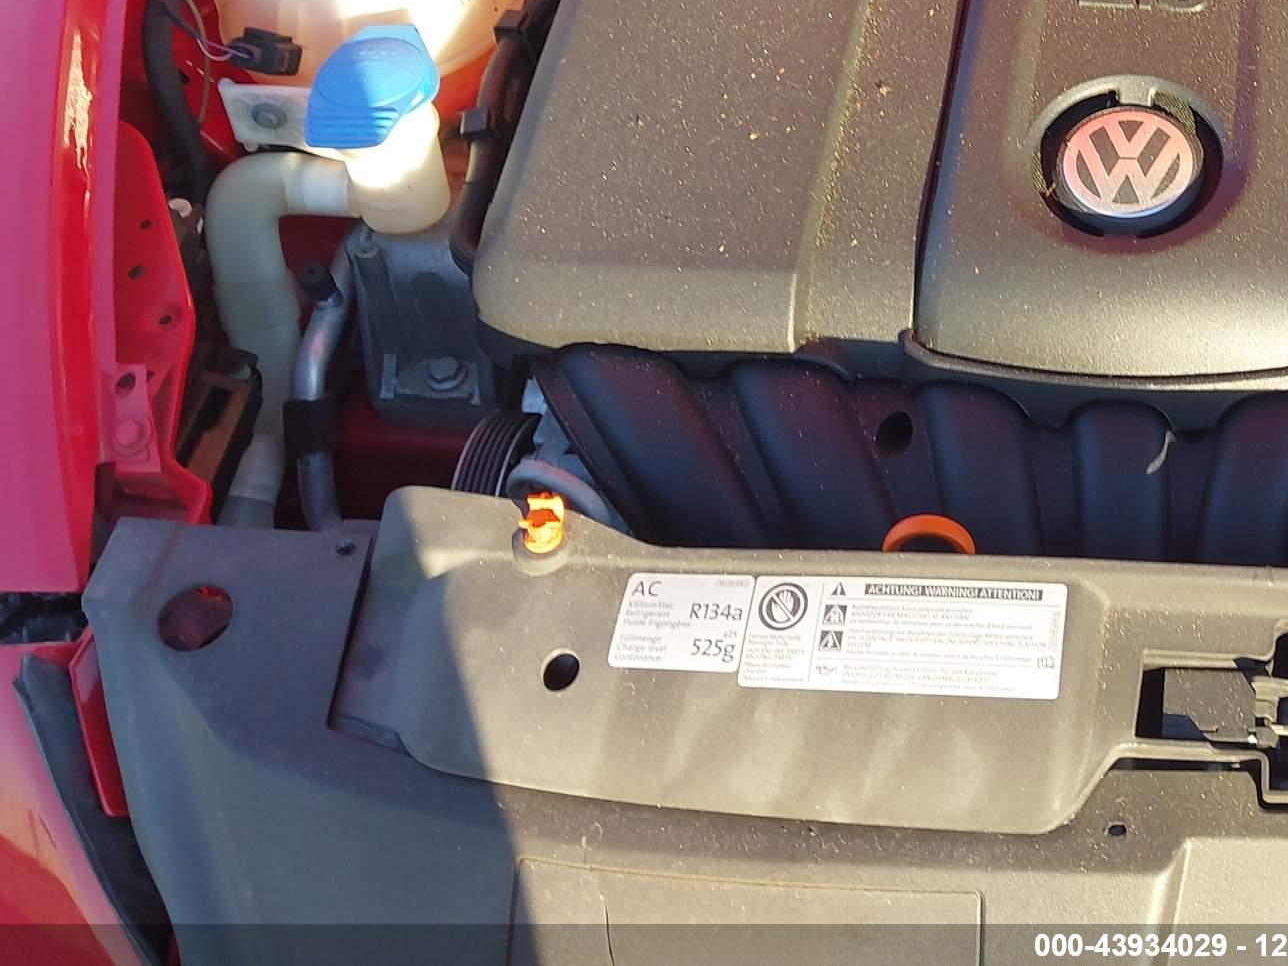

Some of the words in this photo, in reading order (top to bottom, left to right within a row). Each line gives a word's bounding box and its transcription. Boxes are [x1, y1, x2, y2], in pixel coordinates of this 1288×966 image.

[631, 580, 661, 597] AC
[868, 584, 923, 596] ACHTUNG!
[925, 586, 978, 597] WARNING!
[980, 588, 1041, 601] ATTENTION!
[689, 602, 743, 621] R134a
[690, 638, 735, 664] 525g
